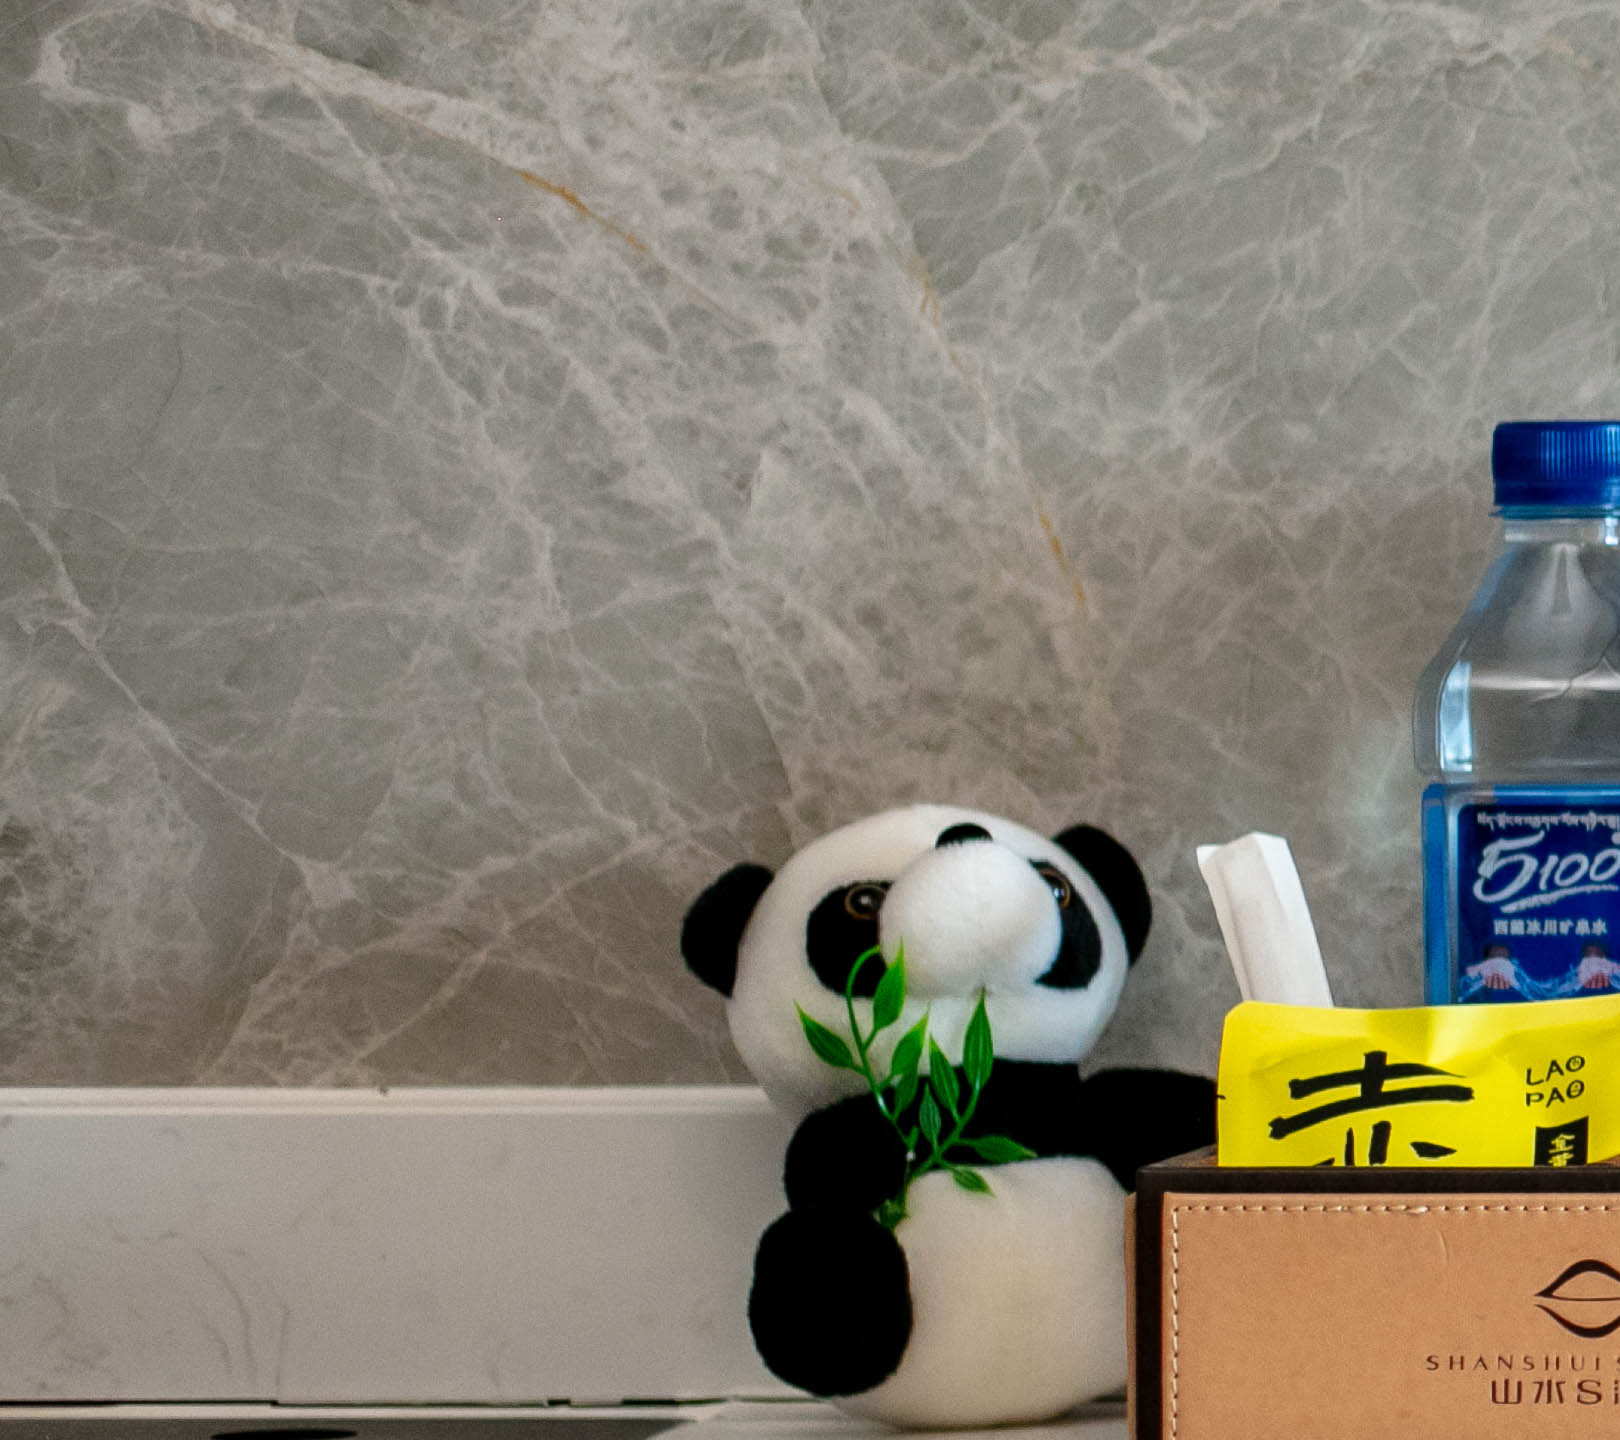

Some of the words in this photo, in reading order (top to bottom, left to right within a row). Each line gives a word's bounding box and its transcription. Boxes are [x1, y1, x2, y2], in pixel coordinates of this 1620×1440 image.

[1493, 919, 1607, 936] 西藏冰川矿泉水
[1525, 1055, 1586, 1086] LAO
[1525, 1079, 1586, 1108] PAO
[1426, 1355, 1601, 1372] SHANSHUI
